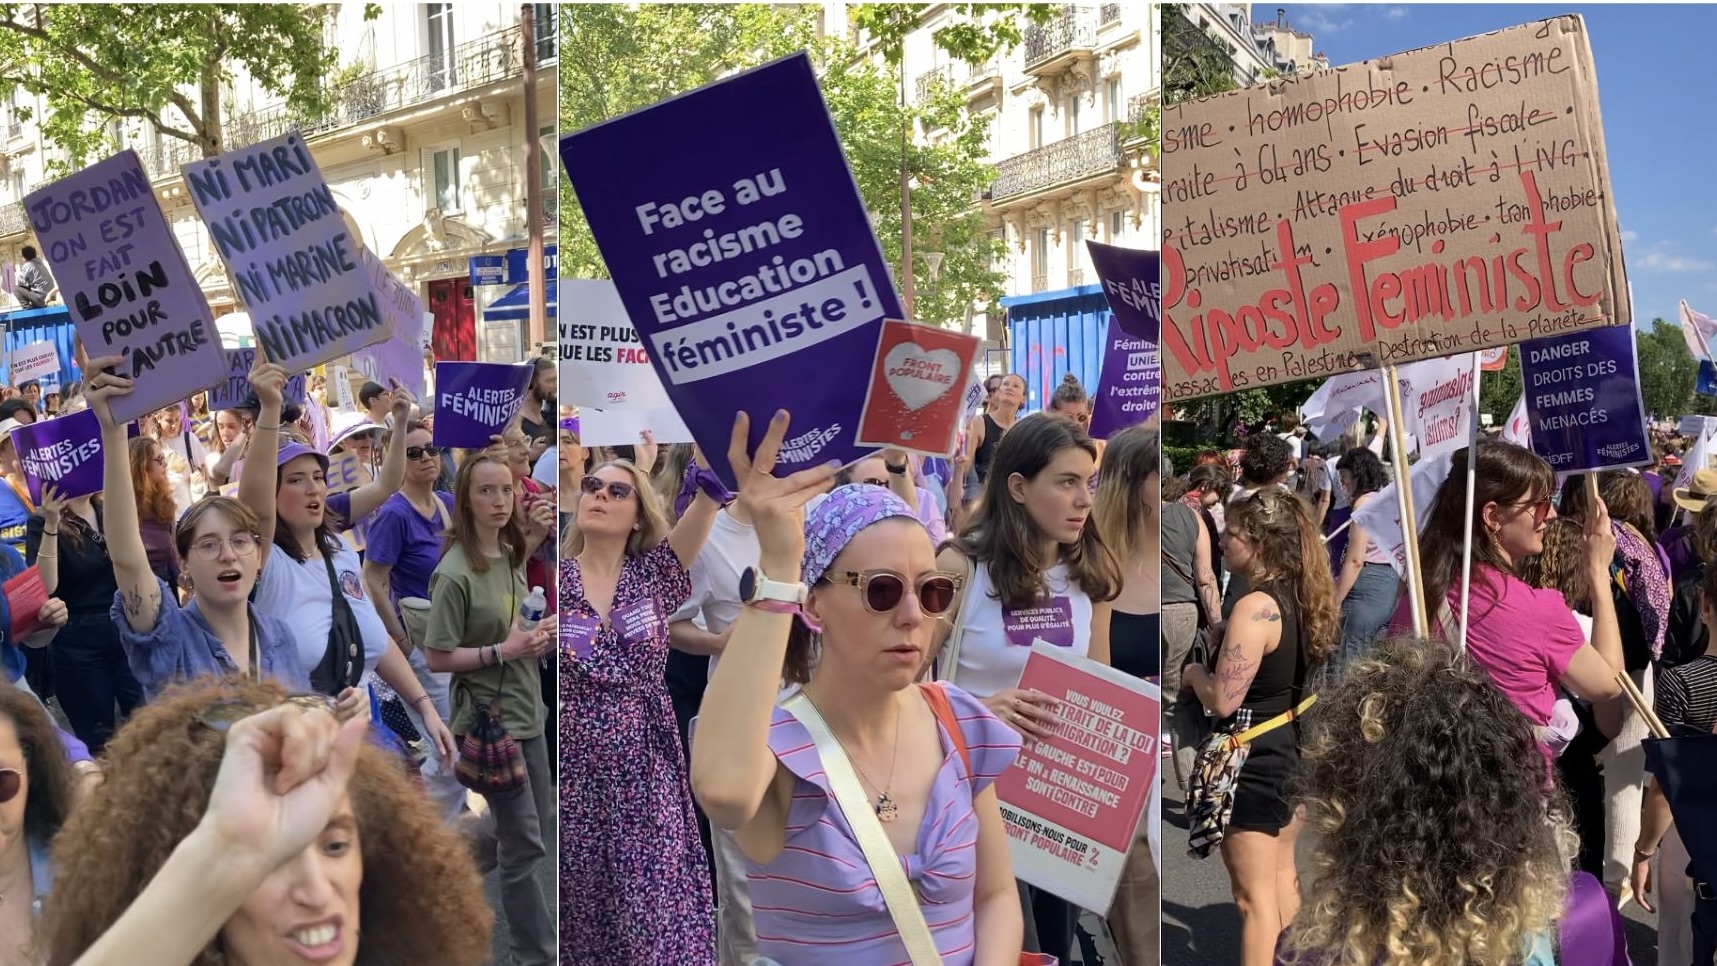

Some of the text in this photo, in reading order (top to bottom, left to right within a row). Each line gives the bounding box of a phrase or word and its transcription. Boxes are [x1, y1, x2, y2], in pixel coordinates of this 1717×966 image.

[1247, 70, 1413, 142] homophobie
[1439, 46, 1570, 95] Racisme
[1235, 147, 1248, 191] à
[1258, 144, 1287, 185] 64
[1292, 144, 1332, 176] ans
[1354, 121, 1448, 166] Evasion
[1464, 99, 1558, 154] fiscale
[1391, 167, 1418, 196] du
[1426, 156, 1476, 191] droit
[1489, 150, 1501, 182] à
[31, 166, 149, 234] JORDAN
[250, 182, 338, 244] PATRON
[634, 167, 787, 236] Face au
[51, 206, 146, 265] ON EST
[652, 211, 804, 279] racisme
[84, 243, 135, 281] FAIT
[649, 248, 845, 324] Education
[102, 300, 169, 345] POUR
[289, 291, 384, 354] MACRON
[571, 323, 597, 340] EST
[600, 325, 640, 343] PLUS
[662, 296, 847, 372] féministe
[586, 345, 612, 362] LES
[902, 357, 943, 373] FRONT
[1256, 365, 1278, 382] en
[1470, 321, 1490, 345] de
[1501, 317, 1518, 339] la
[1528, 310, 1598, 340] planète
[1530, 340, 1590, 365] DANGER
[888, 367, 952, 385] POPULAIRE
[1122, 370, 1160, 382] contre
[1533, 359, 1617, 388] DROITS DES
[467, 386, 515, 404] ALERTES
[1121, 400, 1157, 412] droite
[1536, 387, 1595, 409] FEMMES
[1539, 406, 1609, 431] MENACÉS
[21, 437, 101, 482] FÉMINISTES
[31, 438, 73, 461] ALERTES
[1596, 442, 1640, 459] FÉMINISTES
[1606, 441, 1629, 450] ALERTES
[1025, 622, 1040, 630] PLUS
[1065, 688, 1125, 721] VOUS VOULEZ
[1094, 718, 1113, 736] DE
[1113, 724, 1130, 743] LA
[1130, 731, 1153, 751] LOI
[1013, 754, 1027, 769] LE
[1027, 758, 1045, 776] RN
[1049, 768, 1122, 809] RENAISSANCE
[1034, 740, 1076, 769] GAUCHE
[1076, 759, 1096, 777] EST
[1096, 766, 1128, 790] POUR
[1025, 776, 1097, 817] SONT CONTRE
[1003, 821, 1085, 867] RONT POPULAIRE
[1065, 836, 1089, 854] POUR
